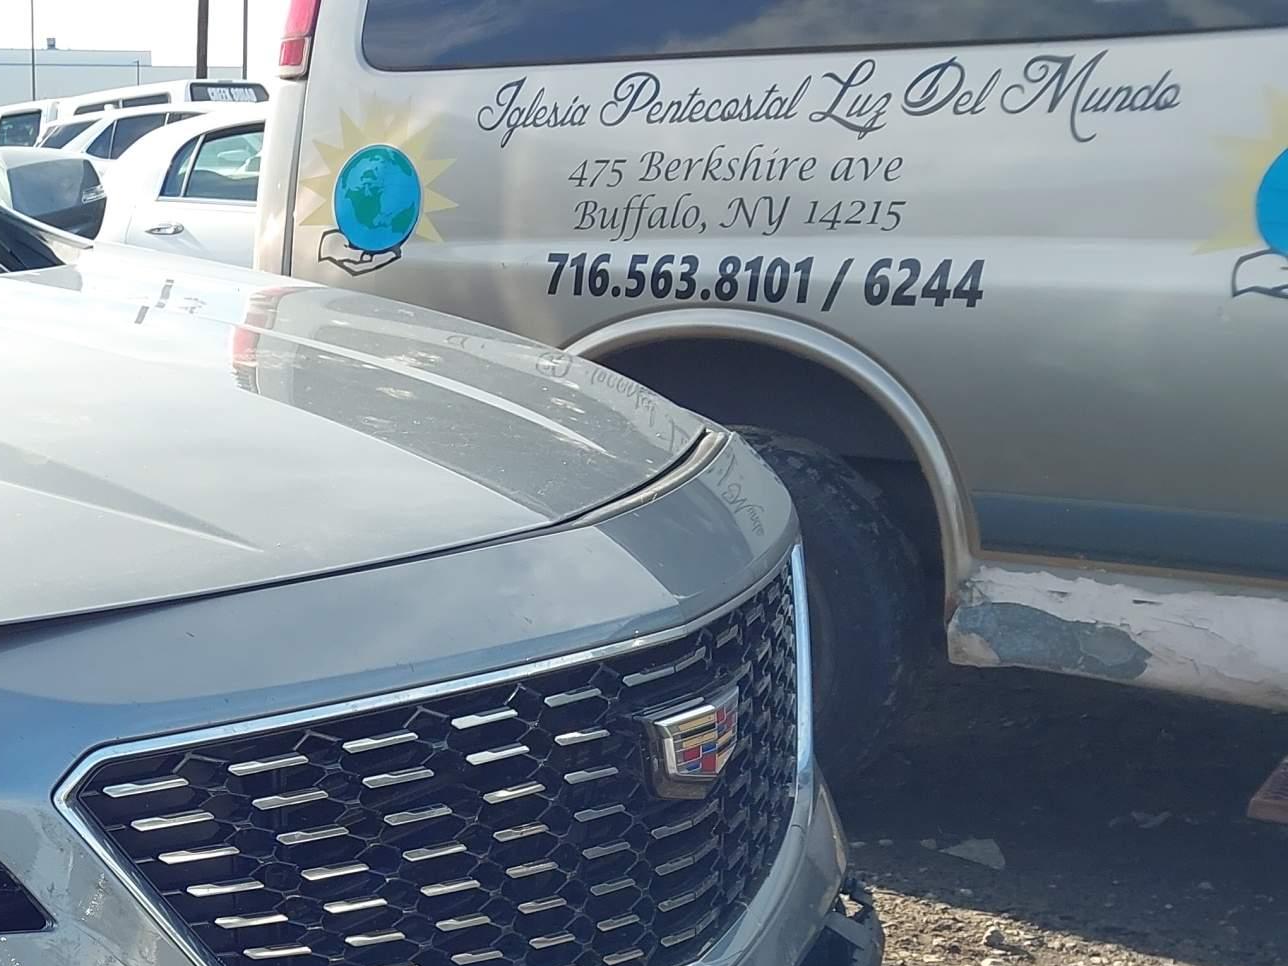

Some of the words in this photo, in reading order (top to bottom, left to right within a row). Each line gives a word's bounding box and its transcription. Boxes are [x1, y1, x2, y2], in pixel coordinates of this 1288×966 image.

[477, 76, 591, 149] Iglesia
[599, 71, 813, 128] Pentecostal
[808, 58, 893, 141] Luz
[901, 55, 1002, 117] Del
[999, 48, 1182, 143] Mundo
[568, 158, 627, 189] 475
[638, 146, 817, 183] Berkshire
[830, 157, 904, 183] ave
[573, 192, 708, 243] Buffalo,
[718, 195, 792, 238] NY
[804, 200, 908, 233] 14215
[546, 251, 815, 305] 716.563.8101
[820, 257, 854, 313] /
[862, 257, 986, 309] 6244
